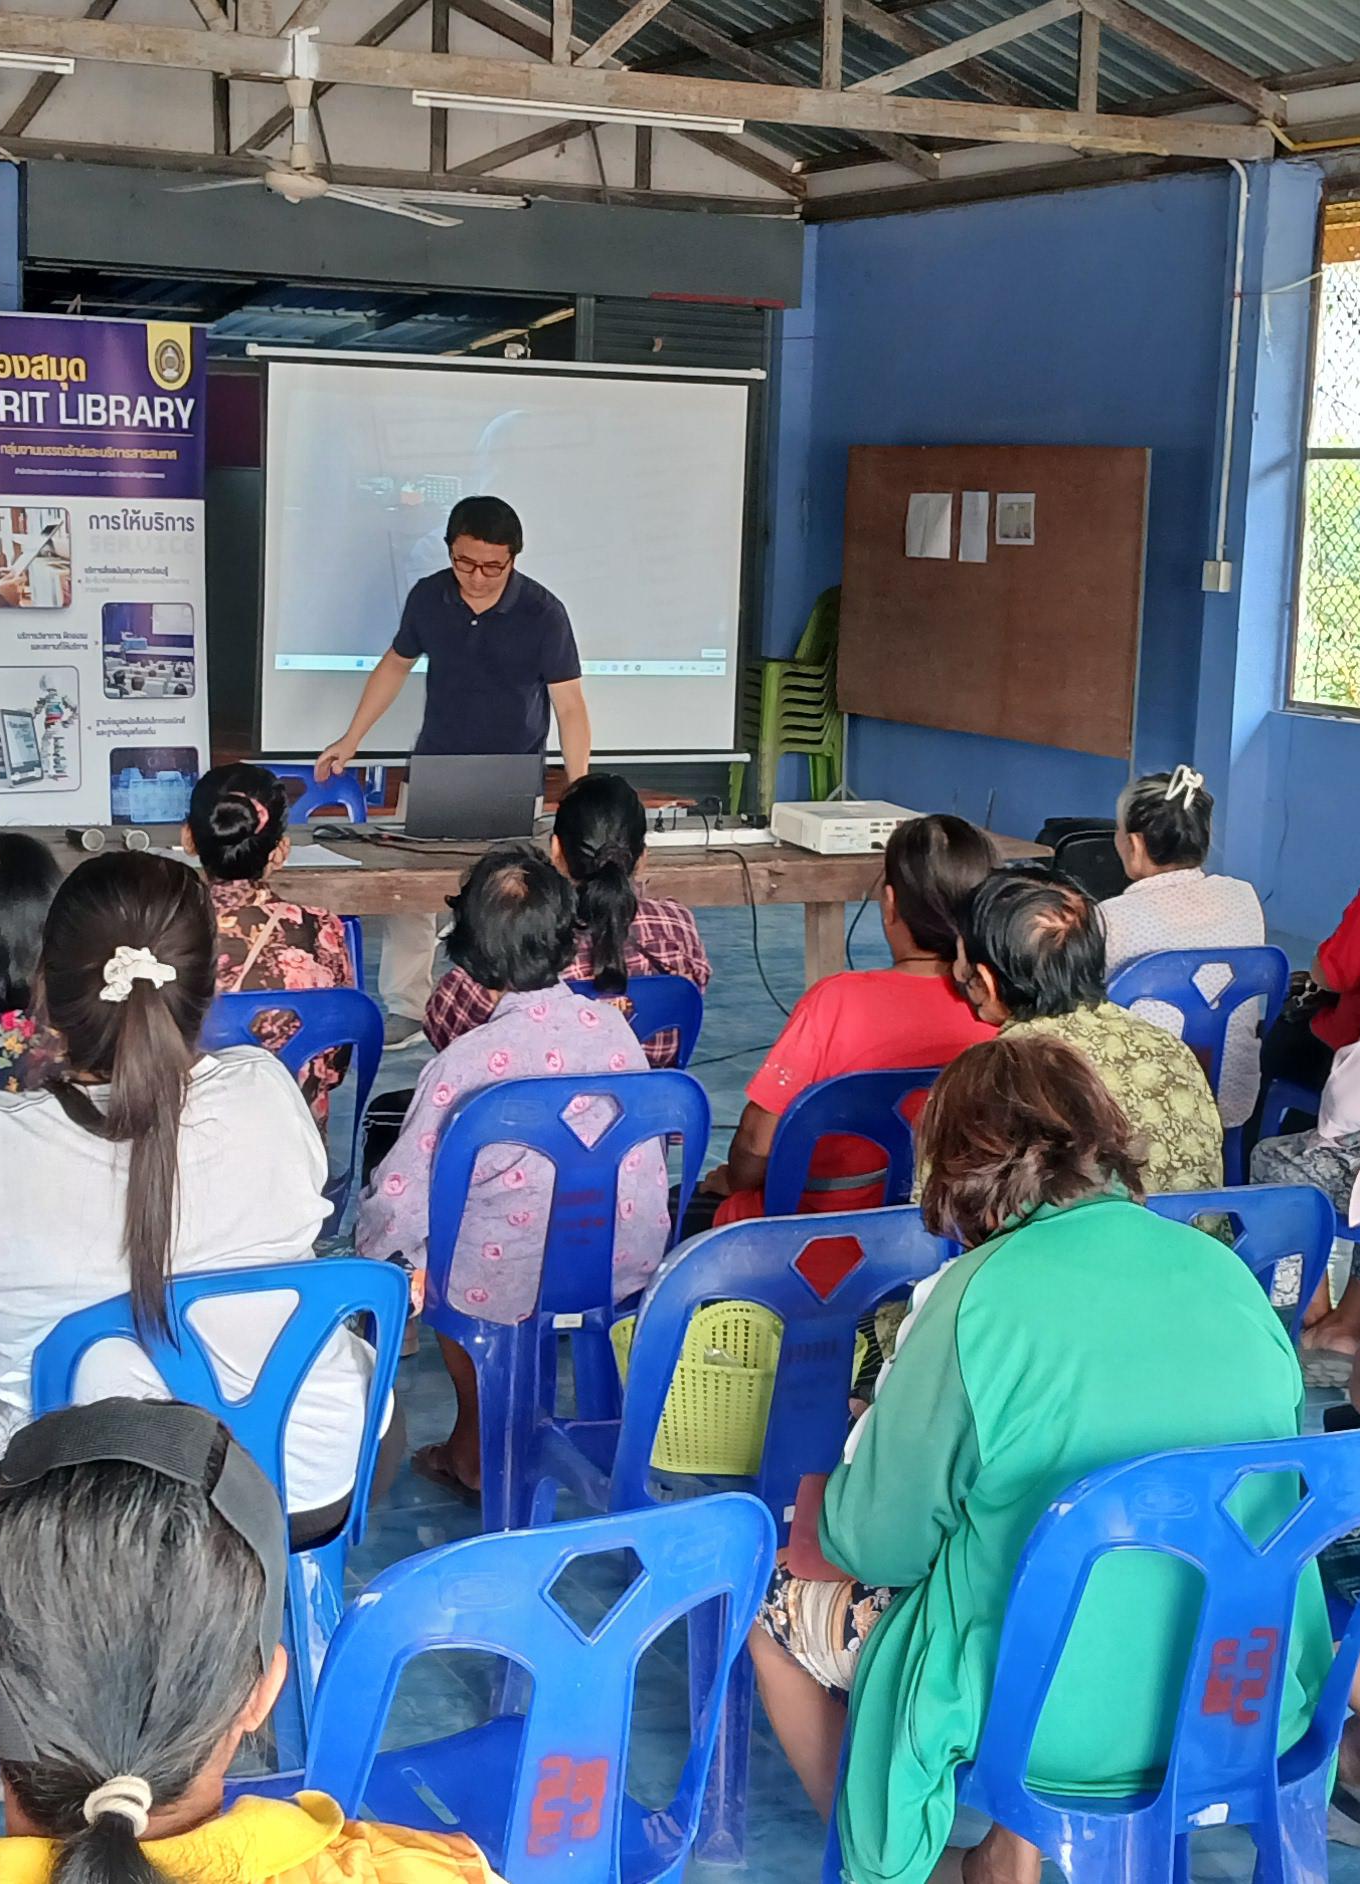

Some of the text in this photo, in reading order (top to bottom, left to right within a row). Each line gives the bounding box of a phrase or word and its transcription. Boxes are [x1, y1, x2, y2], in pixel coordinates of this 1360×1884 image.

[59, 393, 195, 429] LIBRARY
[88, 508, 196, 532] การให้บริการ
